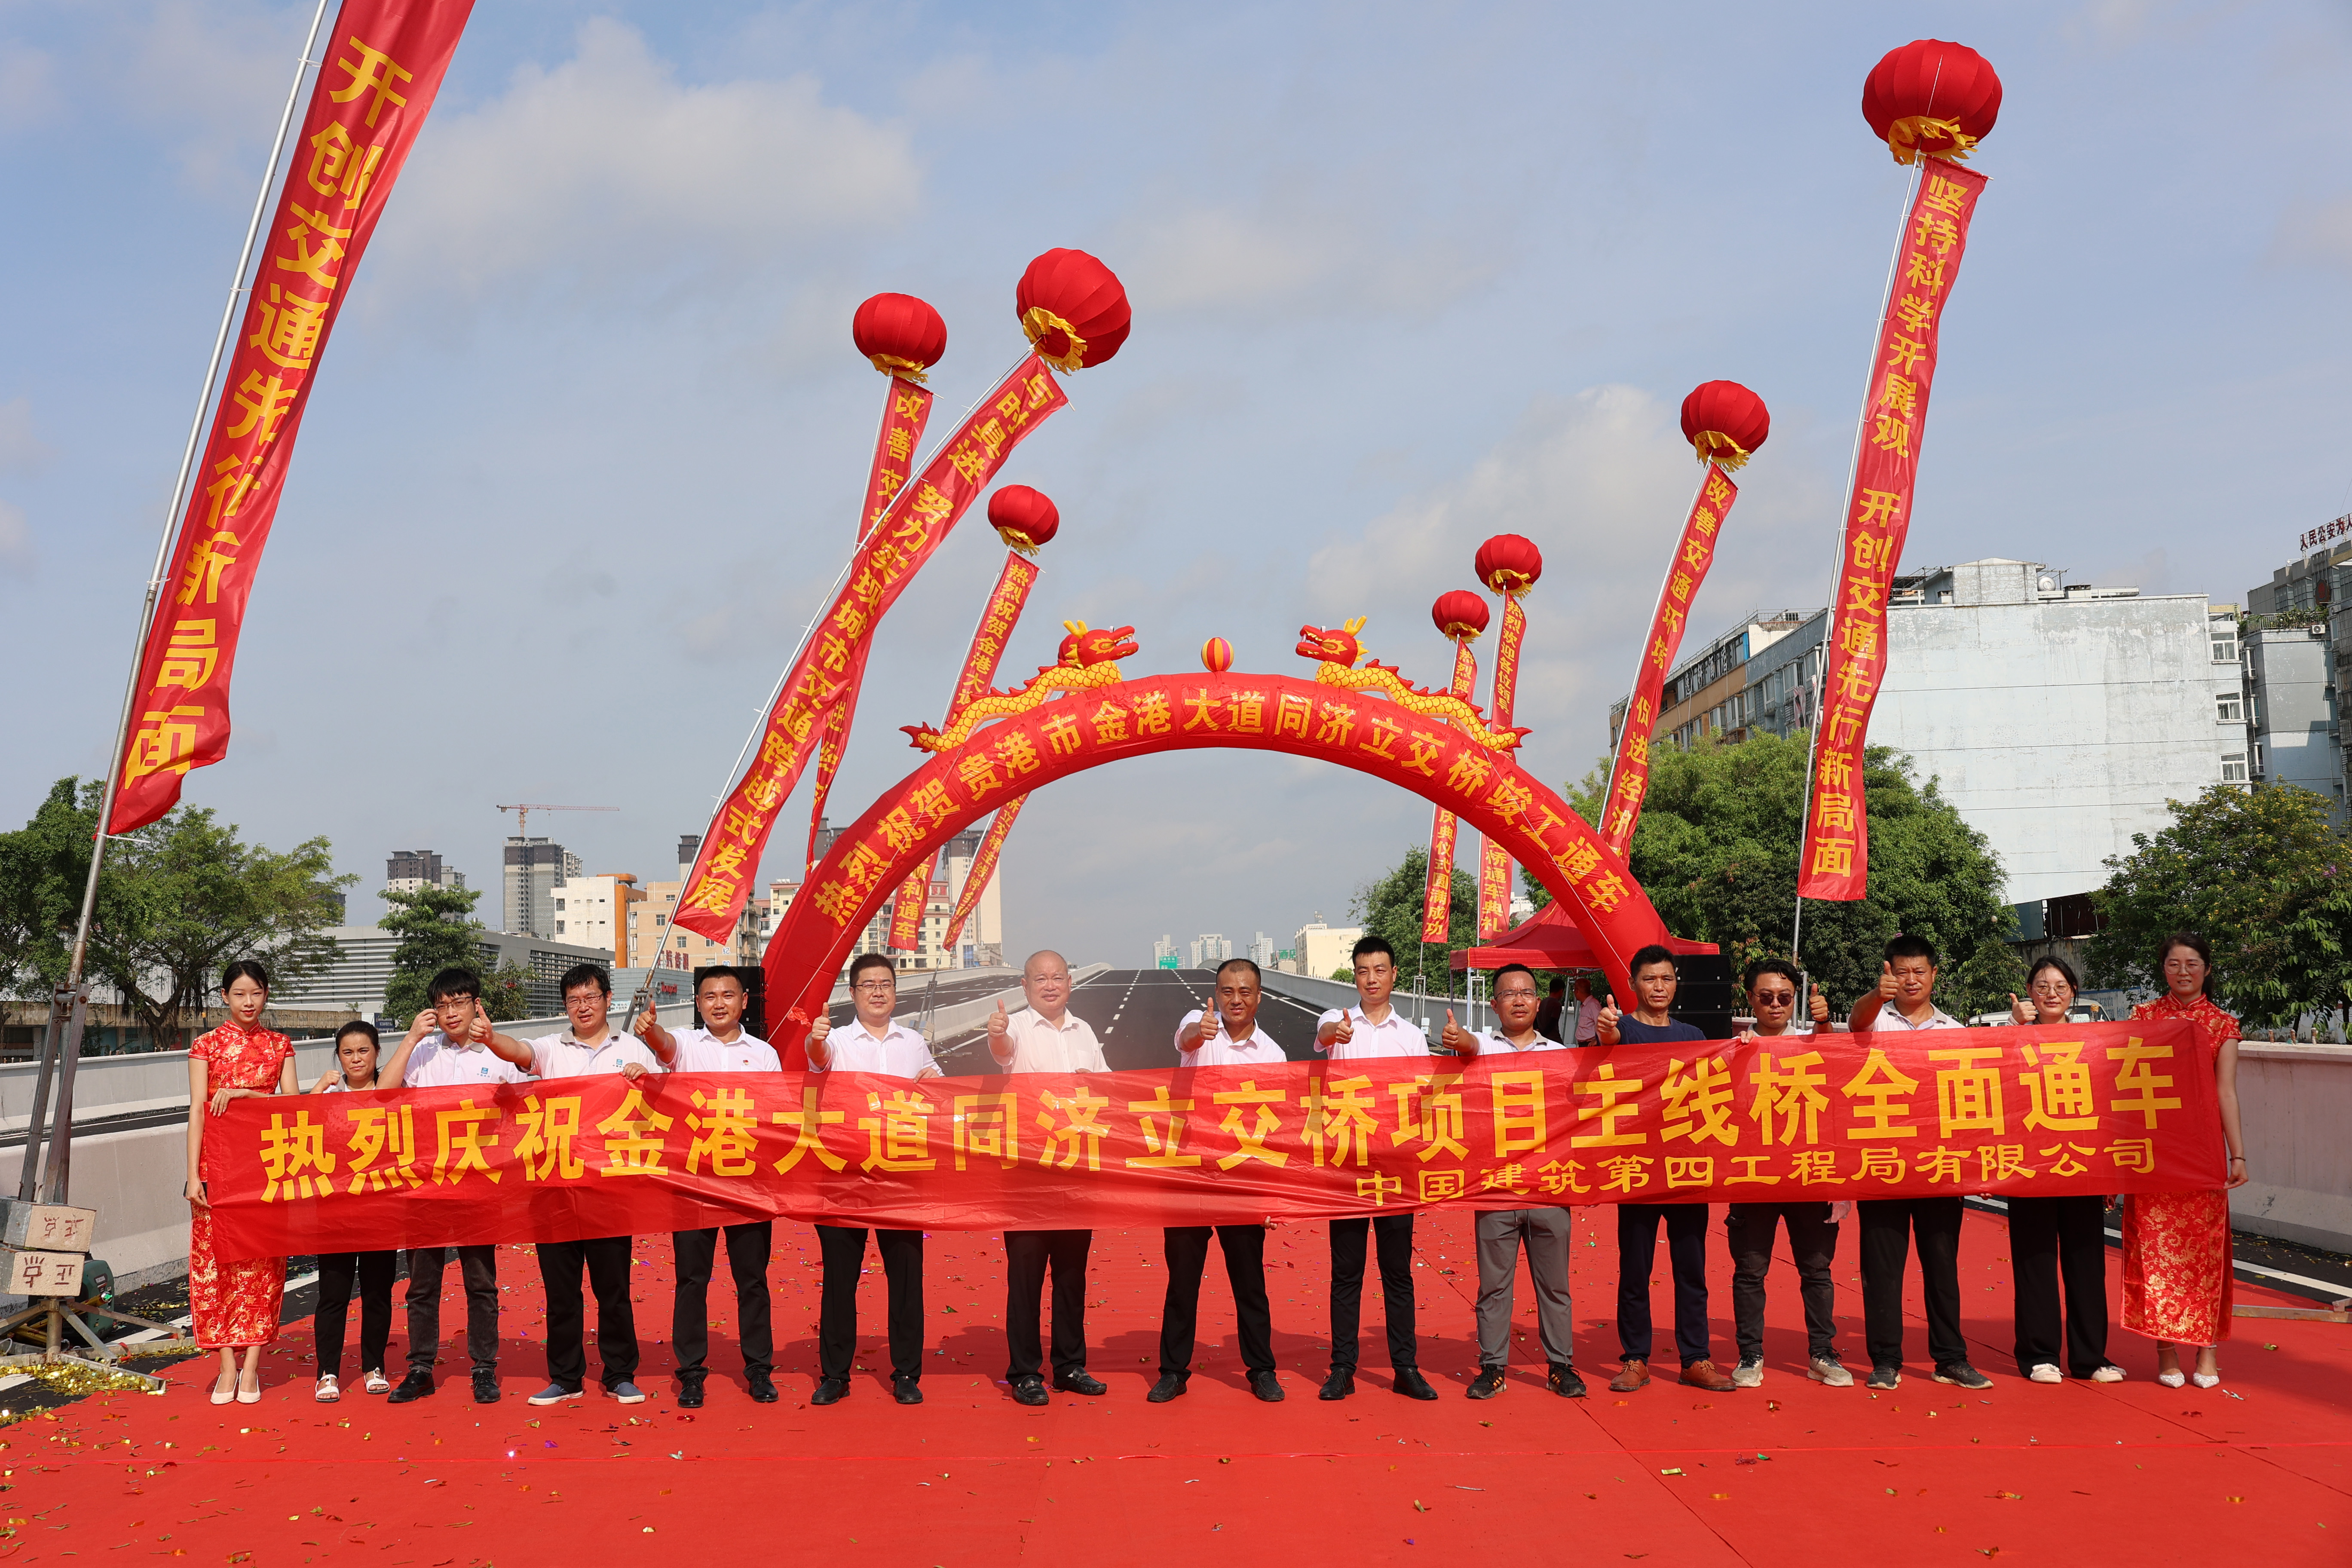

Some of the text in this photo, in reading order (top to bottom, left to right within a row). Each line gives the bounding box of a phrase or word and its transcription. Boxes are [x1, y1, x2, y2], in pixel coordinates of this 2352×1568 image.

[1811, 174, 1968, 878] 坚持科学开展观 开创交通先行新局面
[952, 564, 1029, 720] 热烈祝贺金港大道
[1452, 648, 1474, 695] 热烈贺
[813, 687, 1630, 928] 热烈祝贺贵港市金港大道同济立交桥竣工通车
[1606, 695, 1651, 858] 促进经济
[894, 853, 934, 940] 顺利通车
[1425, 809, 1455, 936] 庆典仪式圆满成功
[259, 1036, 2182, 1204] 热烈庆祝金港大道同济立交桥项目主线桥全面通车
[1356, 1137, 2156, 1207] 中国建筑第四工程局有限公司
